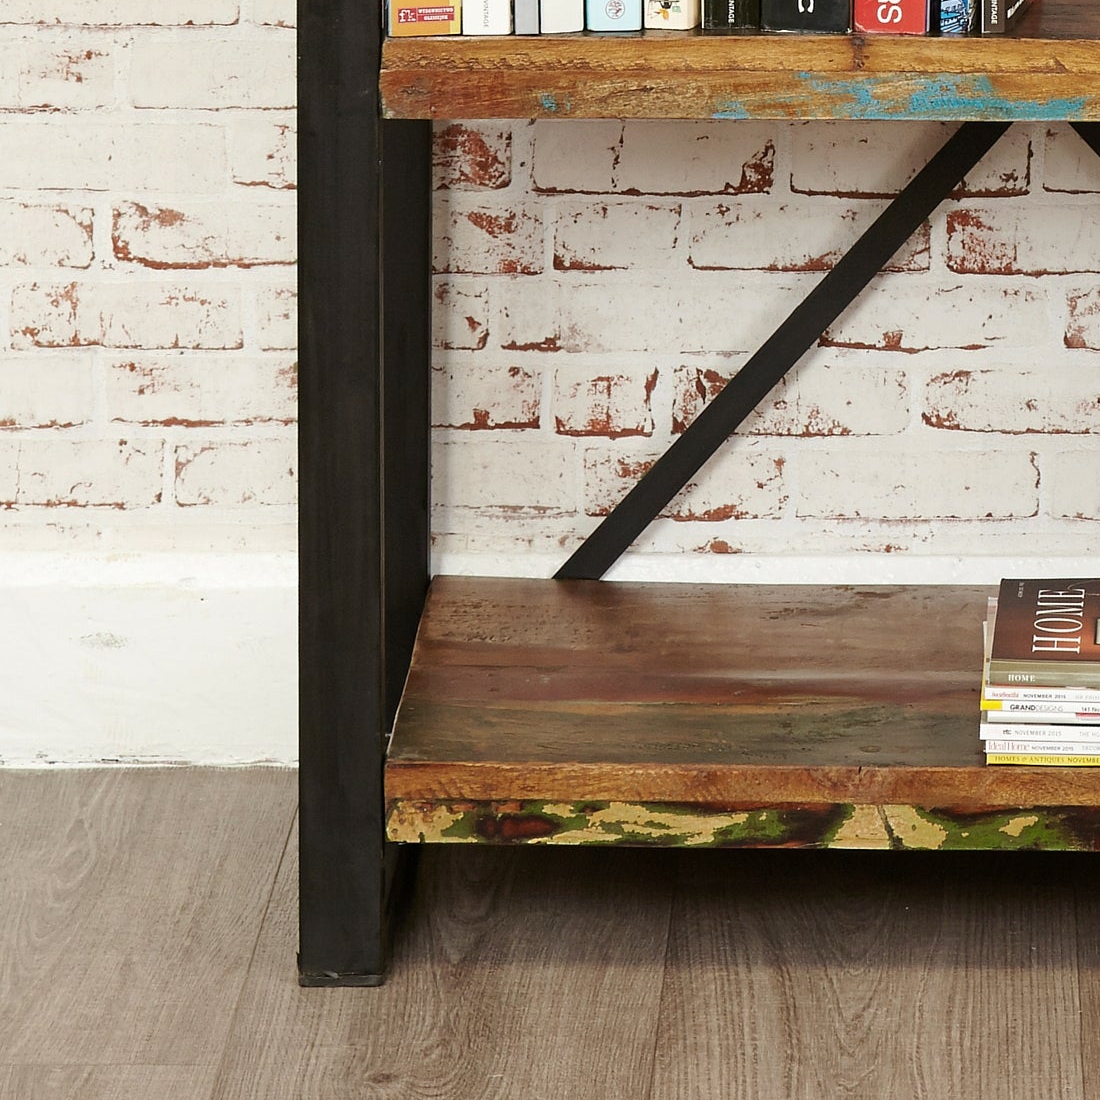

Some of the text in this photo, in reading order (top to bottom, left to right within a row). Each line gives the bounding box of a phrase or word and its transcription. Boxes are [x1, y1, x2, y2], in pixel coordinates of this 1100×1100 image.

[1031, 588, 1085, 654] HOME
[1008, 674, 1036, 682] HOME
[1029, 756, 1065, 764] ANTIQUES
